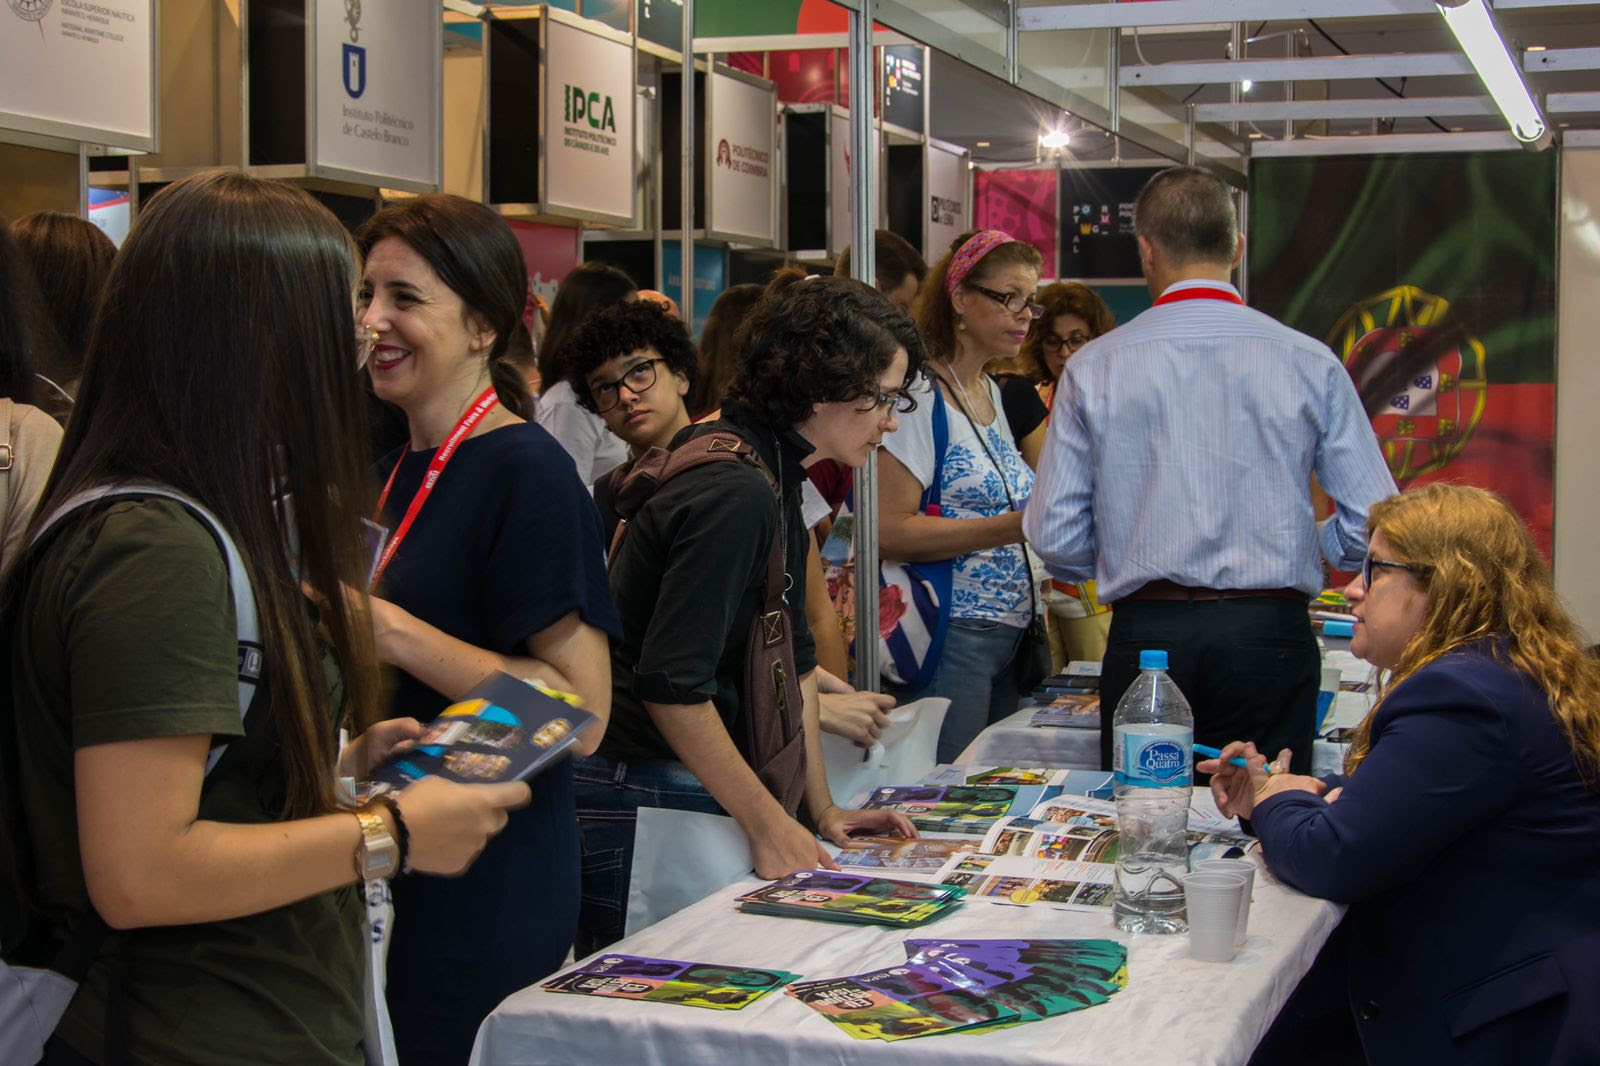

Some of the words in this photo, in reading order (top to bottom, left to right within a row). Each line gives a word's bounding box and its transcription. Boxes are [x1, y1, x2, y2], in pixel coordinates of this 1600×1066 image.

[84, 3, 110, 15] SUPERIOR
[564, 84, 616, 133] IPCA
[342, 104, 374, 121] Instituto
[375, 110, 415, 131] Politécnico
[342, 122, 353, 136] de
[354, 124, 383, 141] Castelo
[383, 129, 410, 146] Branco
[733, 144, 768, 163] POLITÉCNICO
[733, 159, 741, 172] DE
[742, 161, 769, 178] COIMBRA
[438, 425, 469, 461] Recruitment
[463, 411, 480, 427] Fairs
[1149, 749, 1180, 762] Passa
[1146, 758, 1180, 770] Quatro
[858, 972, 890, 983] ISPA
[814, 987, 851, 998] ISPA
[815, 990, 871, 1006] ESTUDO
[844, 997, 873, 1009] EU
